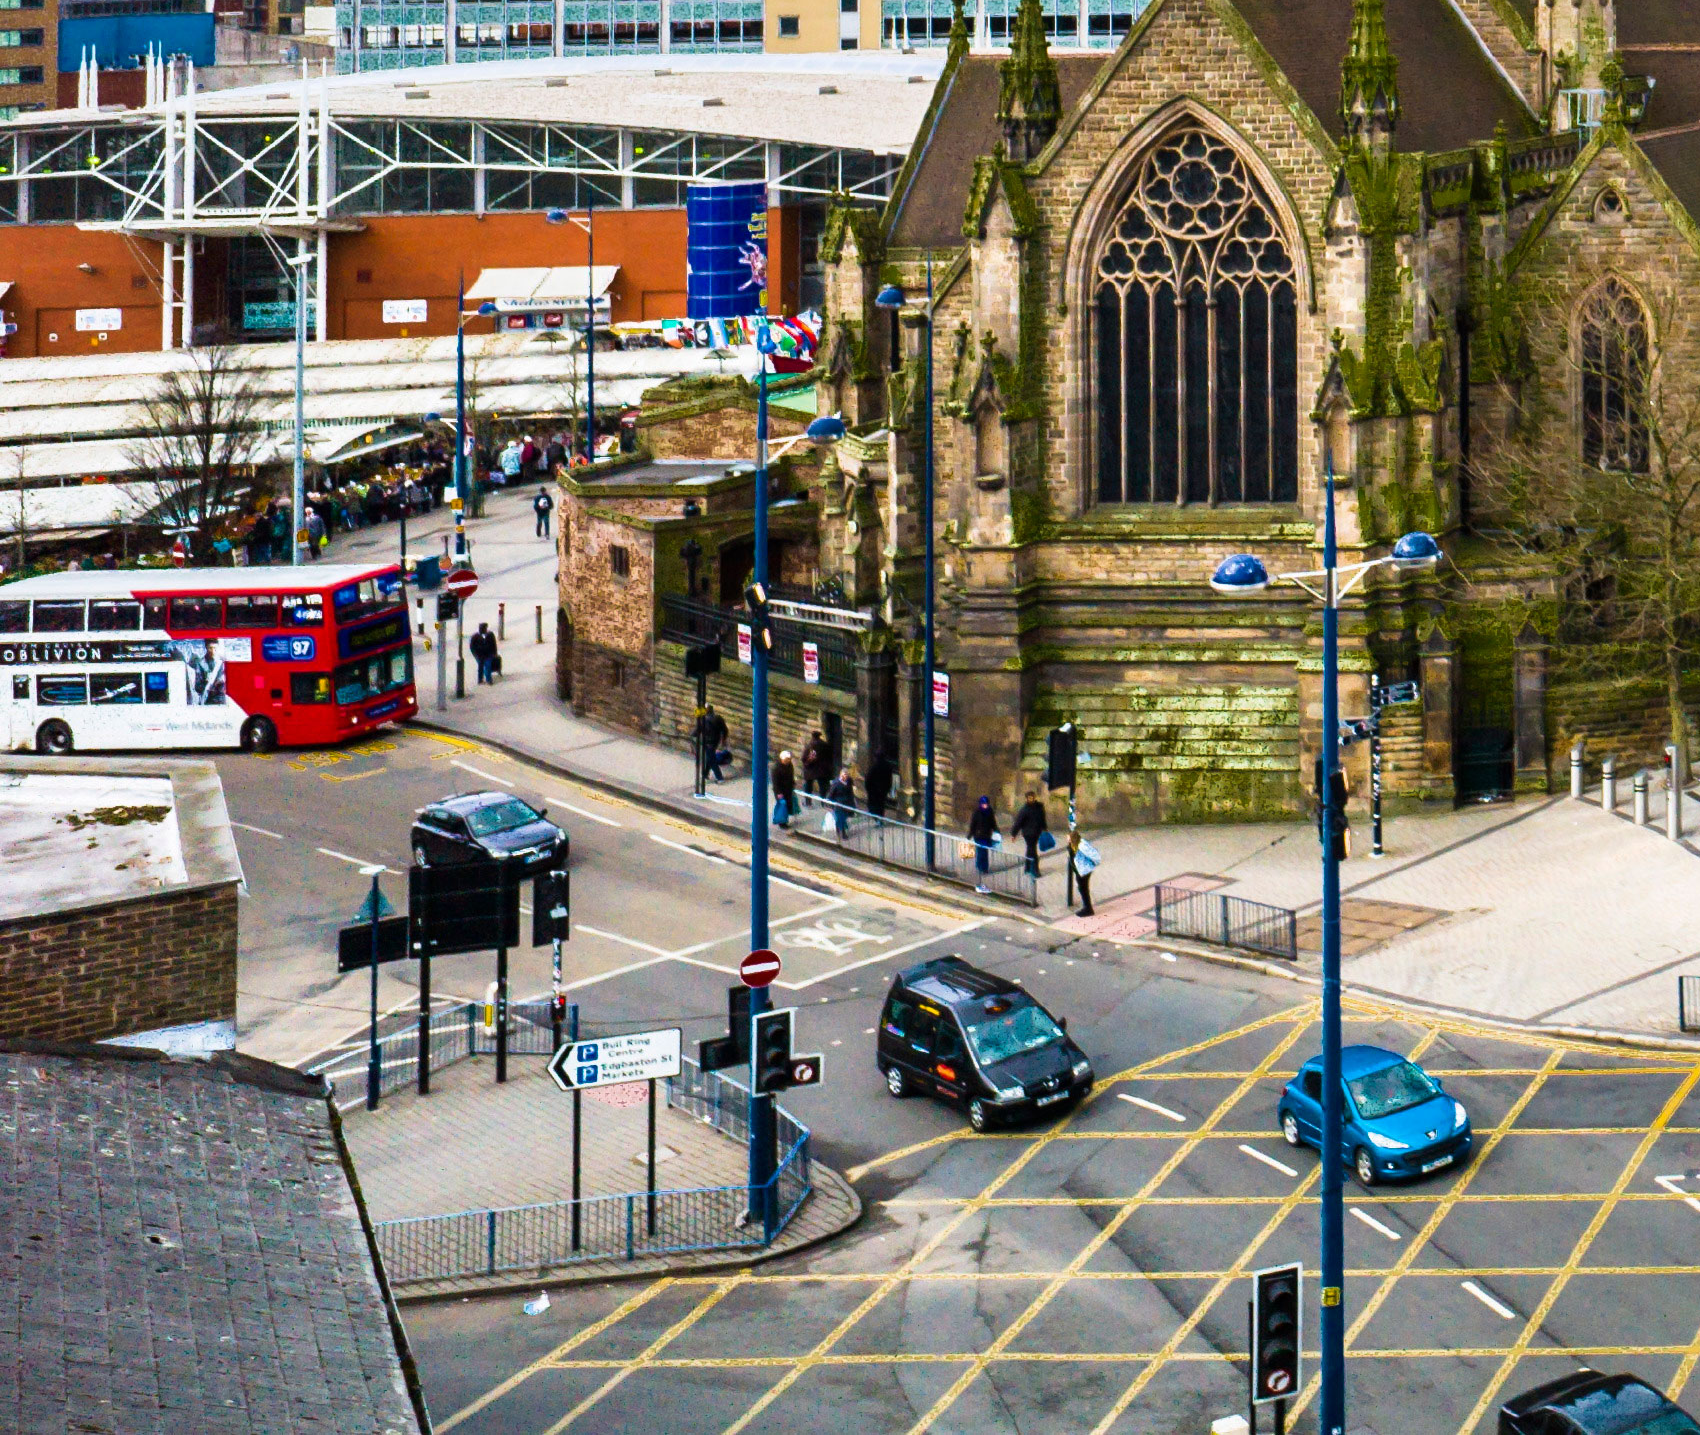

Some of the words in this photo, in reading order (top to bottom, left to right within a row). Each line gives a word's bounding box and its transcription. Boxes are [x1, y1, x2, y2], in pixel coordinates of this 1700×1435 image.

[292, 640, 310, 655] 97
[3, 648, 101, 662] OBLIVION
[602, 1041, 622, 1050] Bull
[627, 1038, 651, 1046] Ring
[608, 1048, 644, 1058] Centre
[601, 1057, 657, 1071] Edgbaston
[660, 1054, 672, 1063] St
[602, 1070, 644, 1080] Markets
